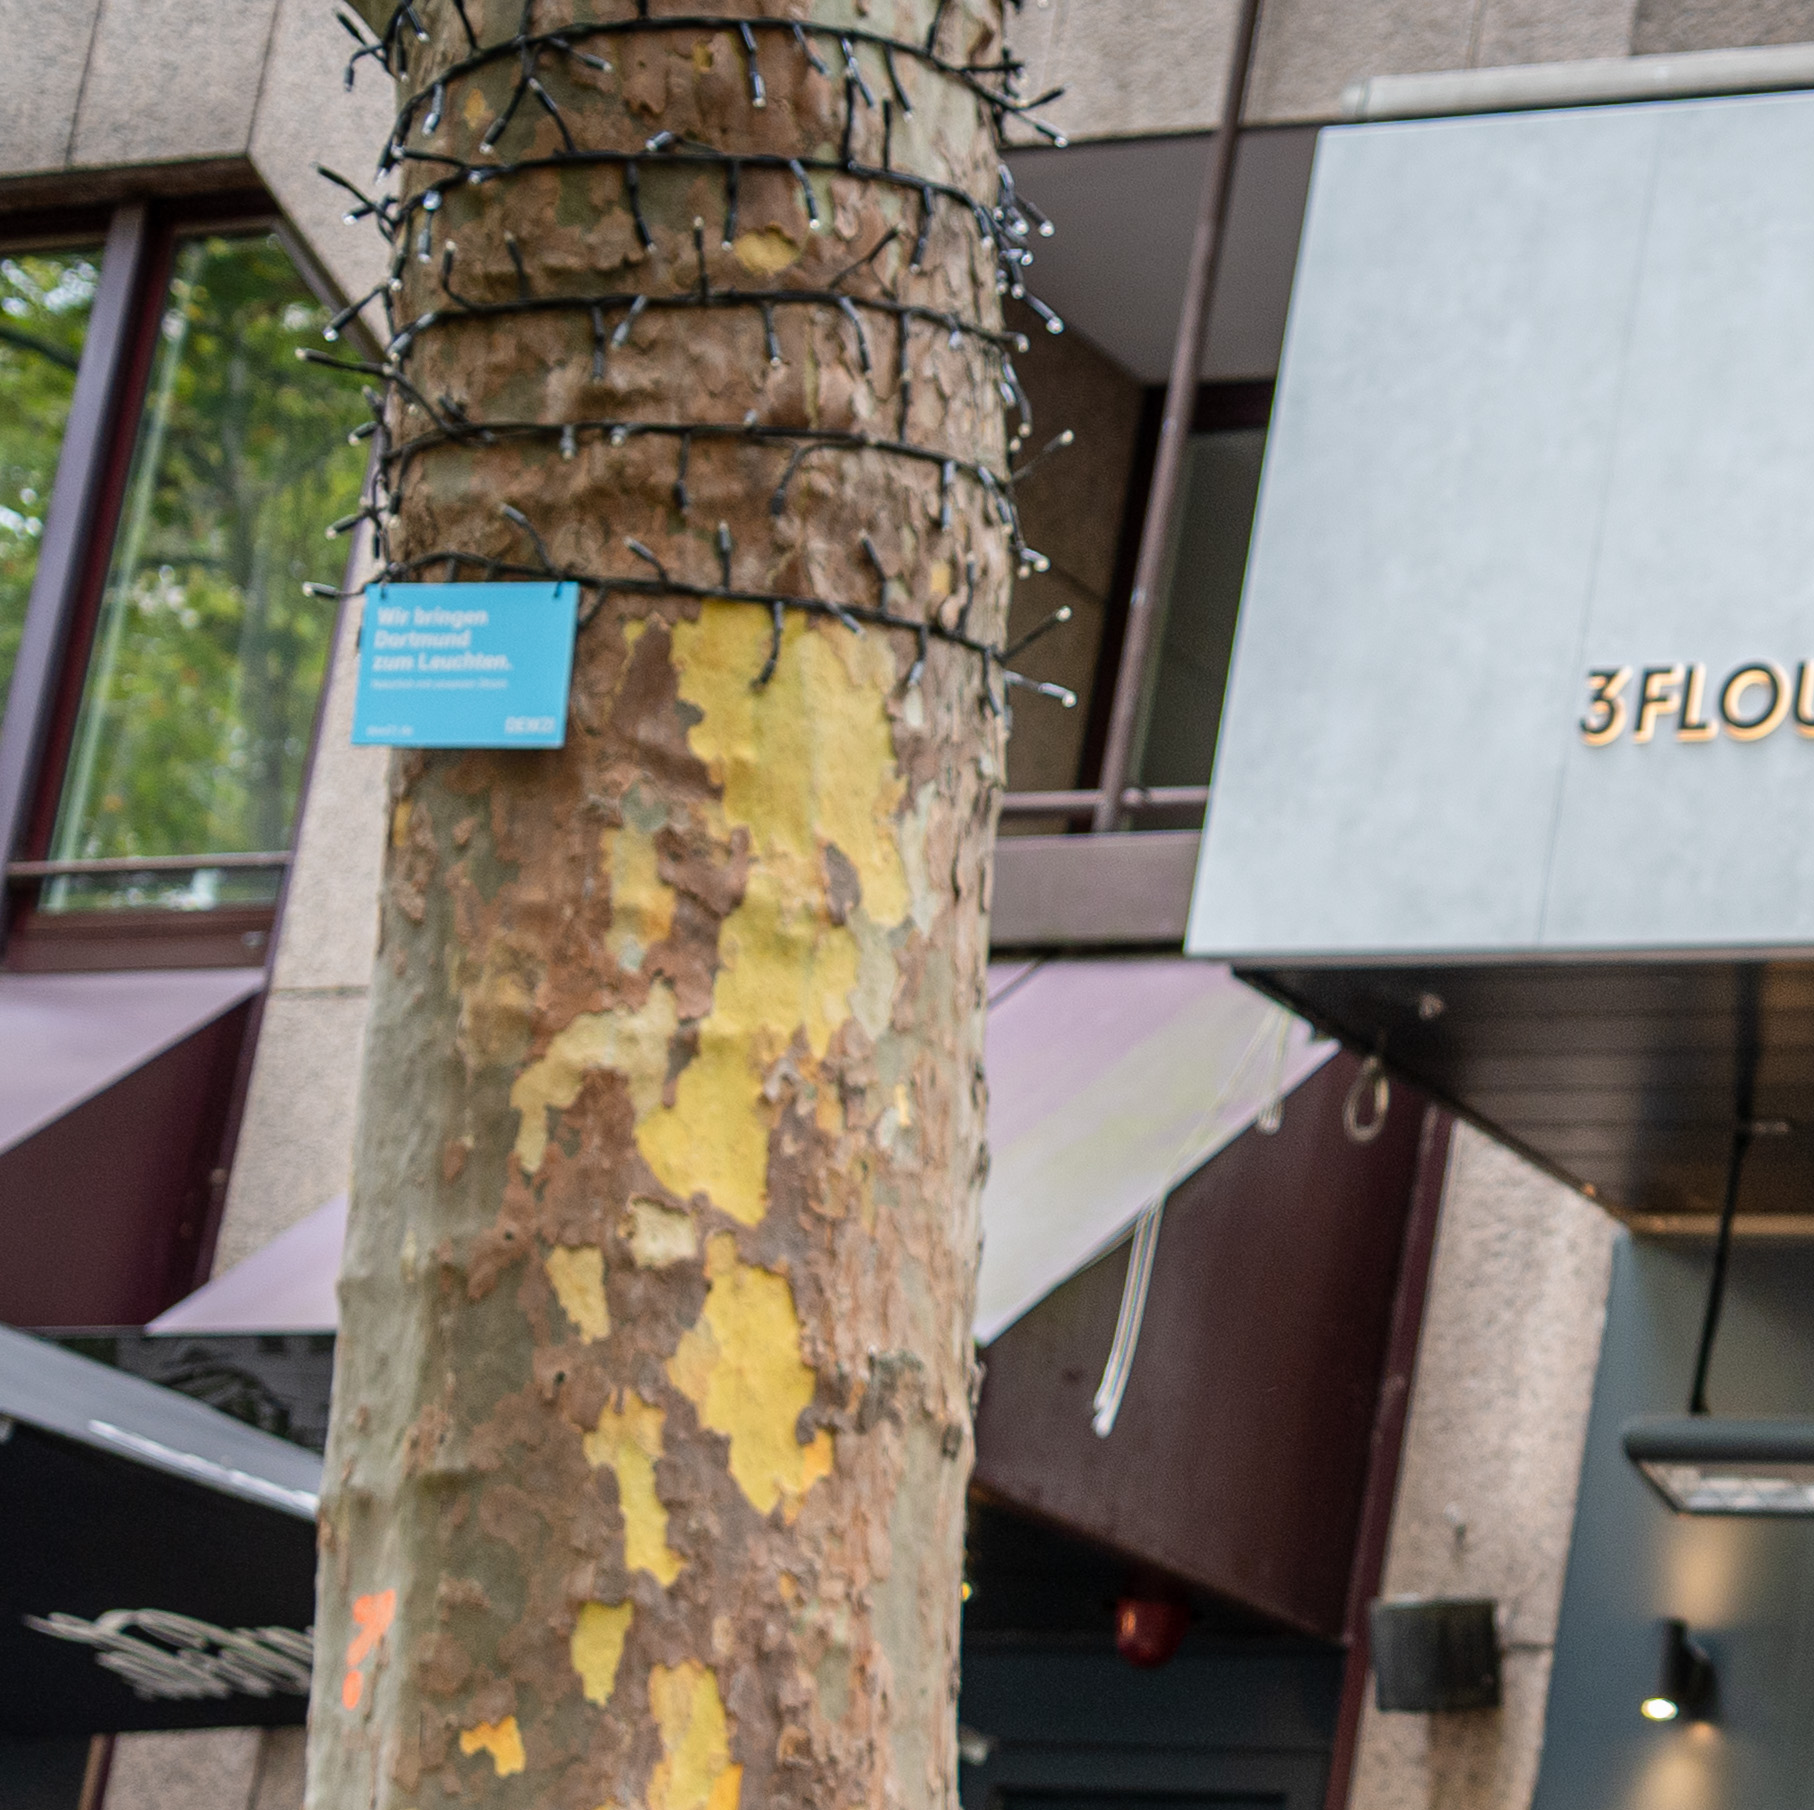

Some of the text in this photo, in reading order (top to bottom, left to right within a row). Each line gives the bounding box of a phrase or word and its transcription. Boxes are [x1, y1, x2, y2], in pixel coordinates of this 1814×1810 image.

[377, 606, 489, 630] Wir bringen
[373, 628, 472, 649] Dortmund
[371, 651, 513, 672] zum Leuchten.
